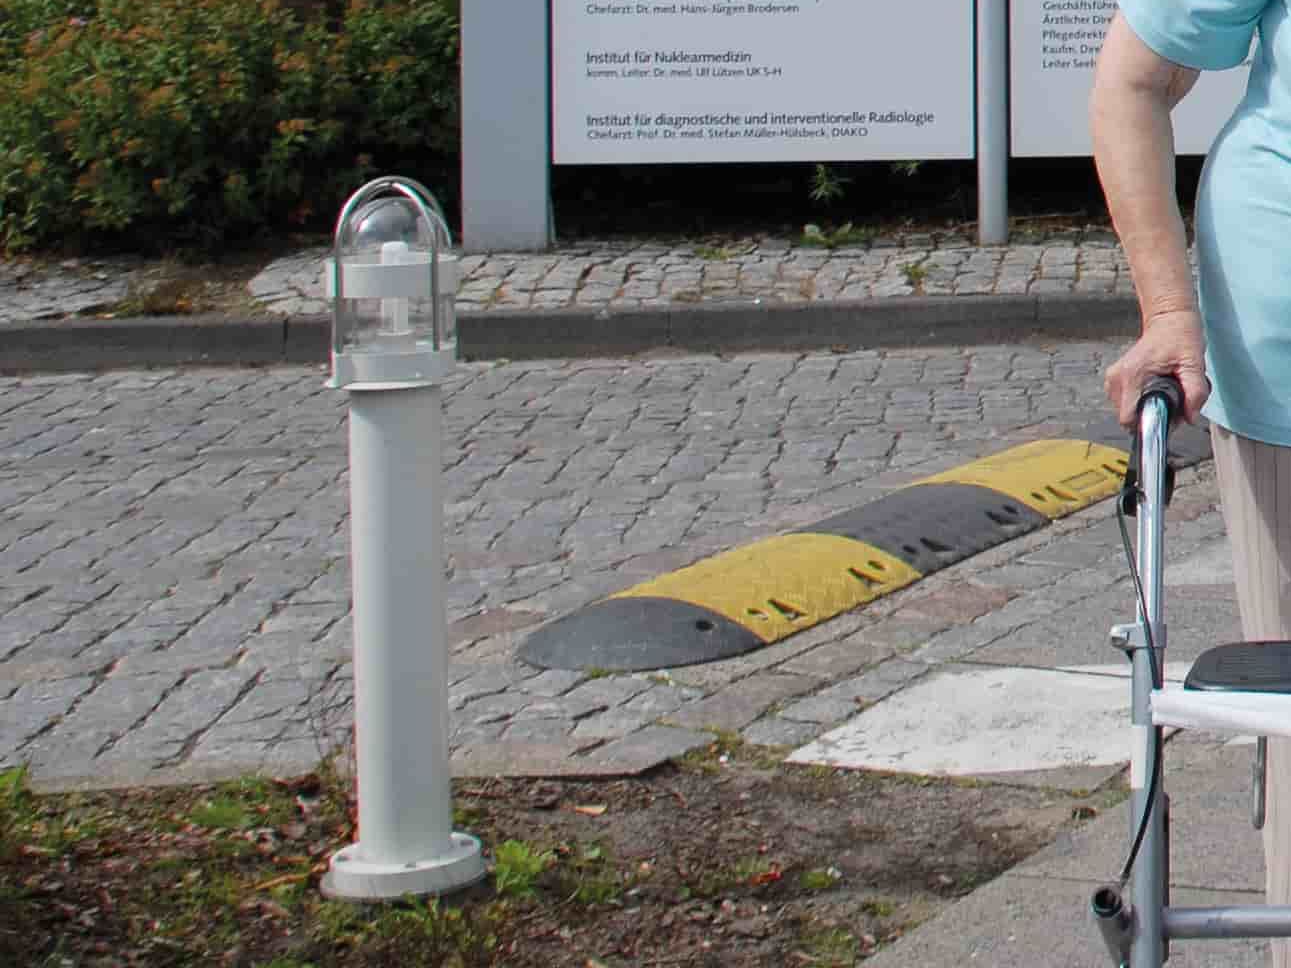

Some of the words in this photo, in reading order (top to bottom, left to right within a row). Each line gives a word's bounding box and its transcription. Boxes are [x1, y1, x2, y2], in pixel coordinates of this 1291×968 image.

[1042, 14, 1089, 25] Ärztlicher
[586, 51, 630, 64] Institut
[634, 51, 652, 63] für
[655, 51, 752, 64] Nuklearmedizin
[586, 114, 630, 127] Institut
[634, 113, 652, 126] für
[655, 113, 741, 129] diagnostische
[744, 113, 768, 125] und
[771, 112, 866, 125] interventionelle
[869, 111, 935, 127] Radiologie
